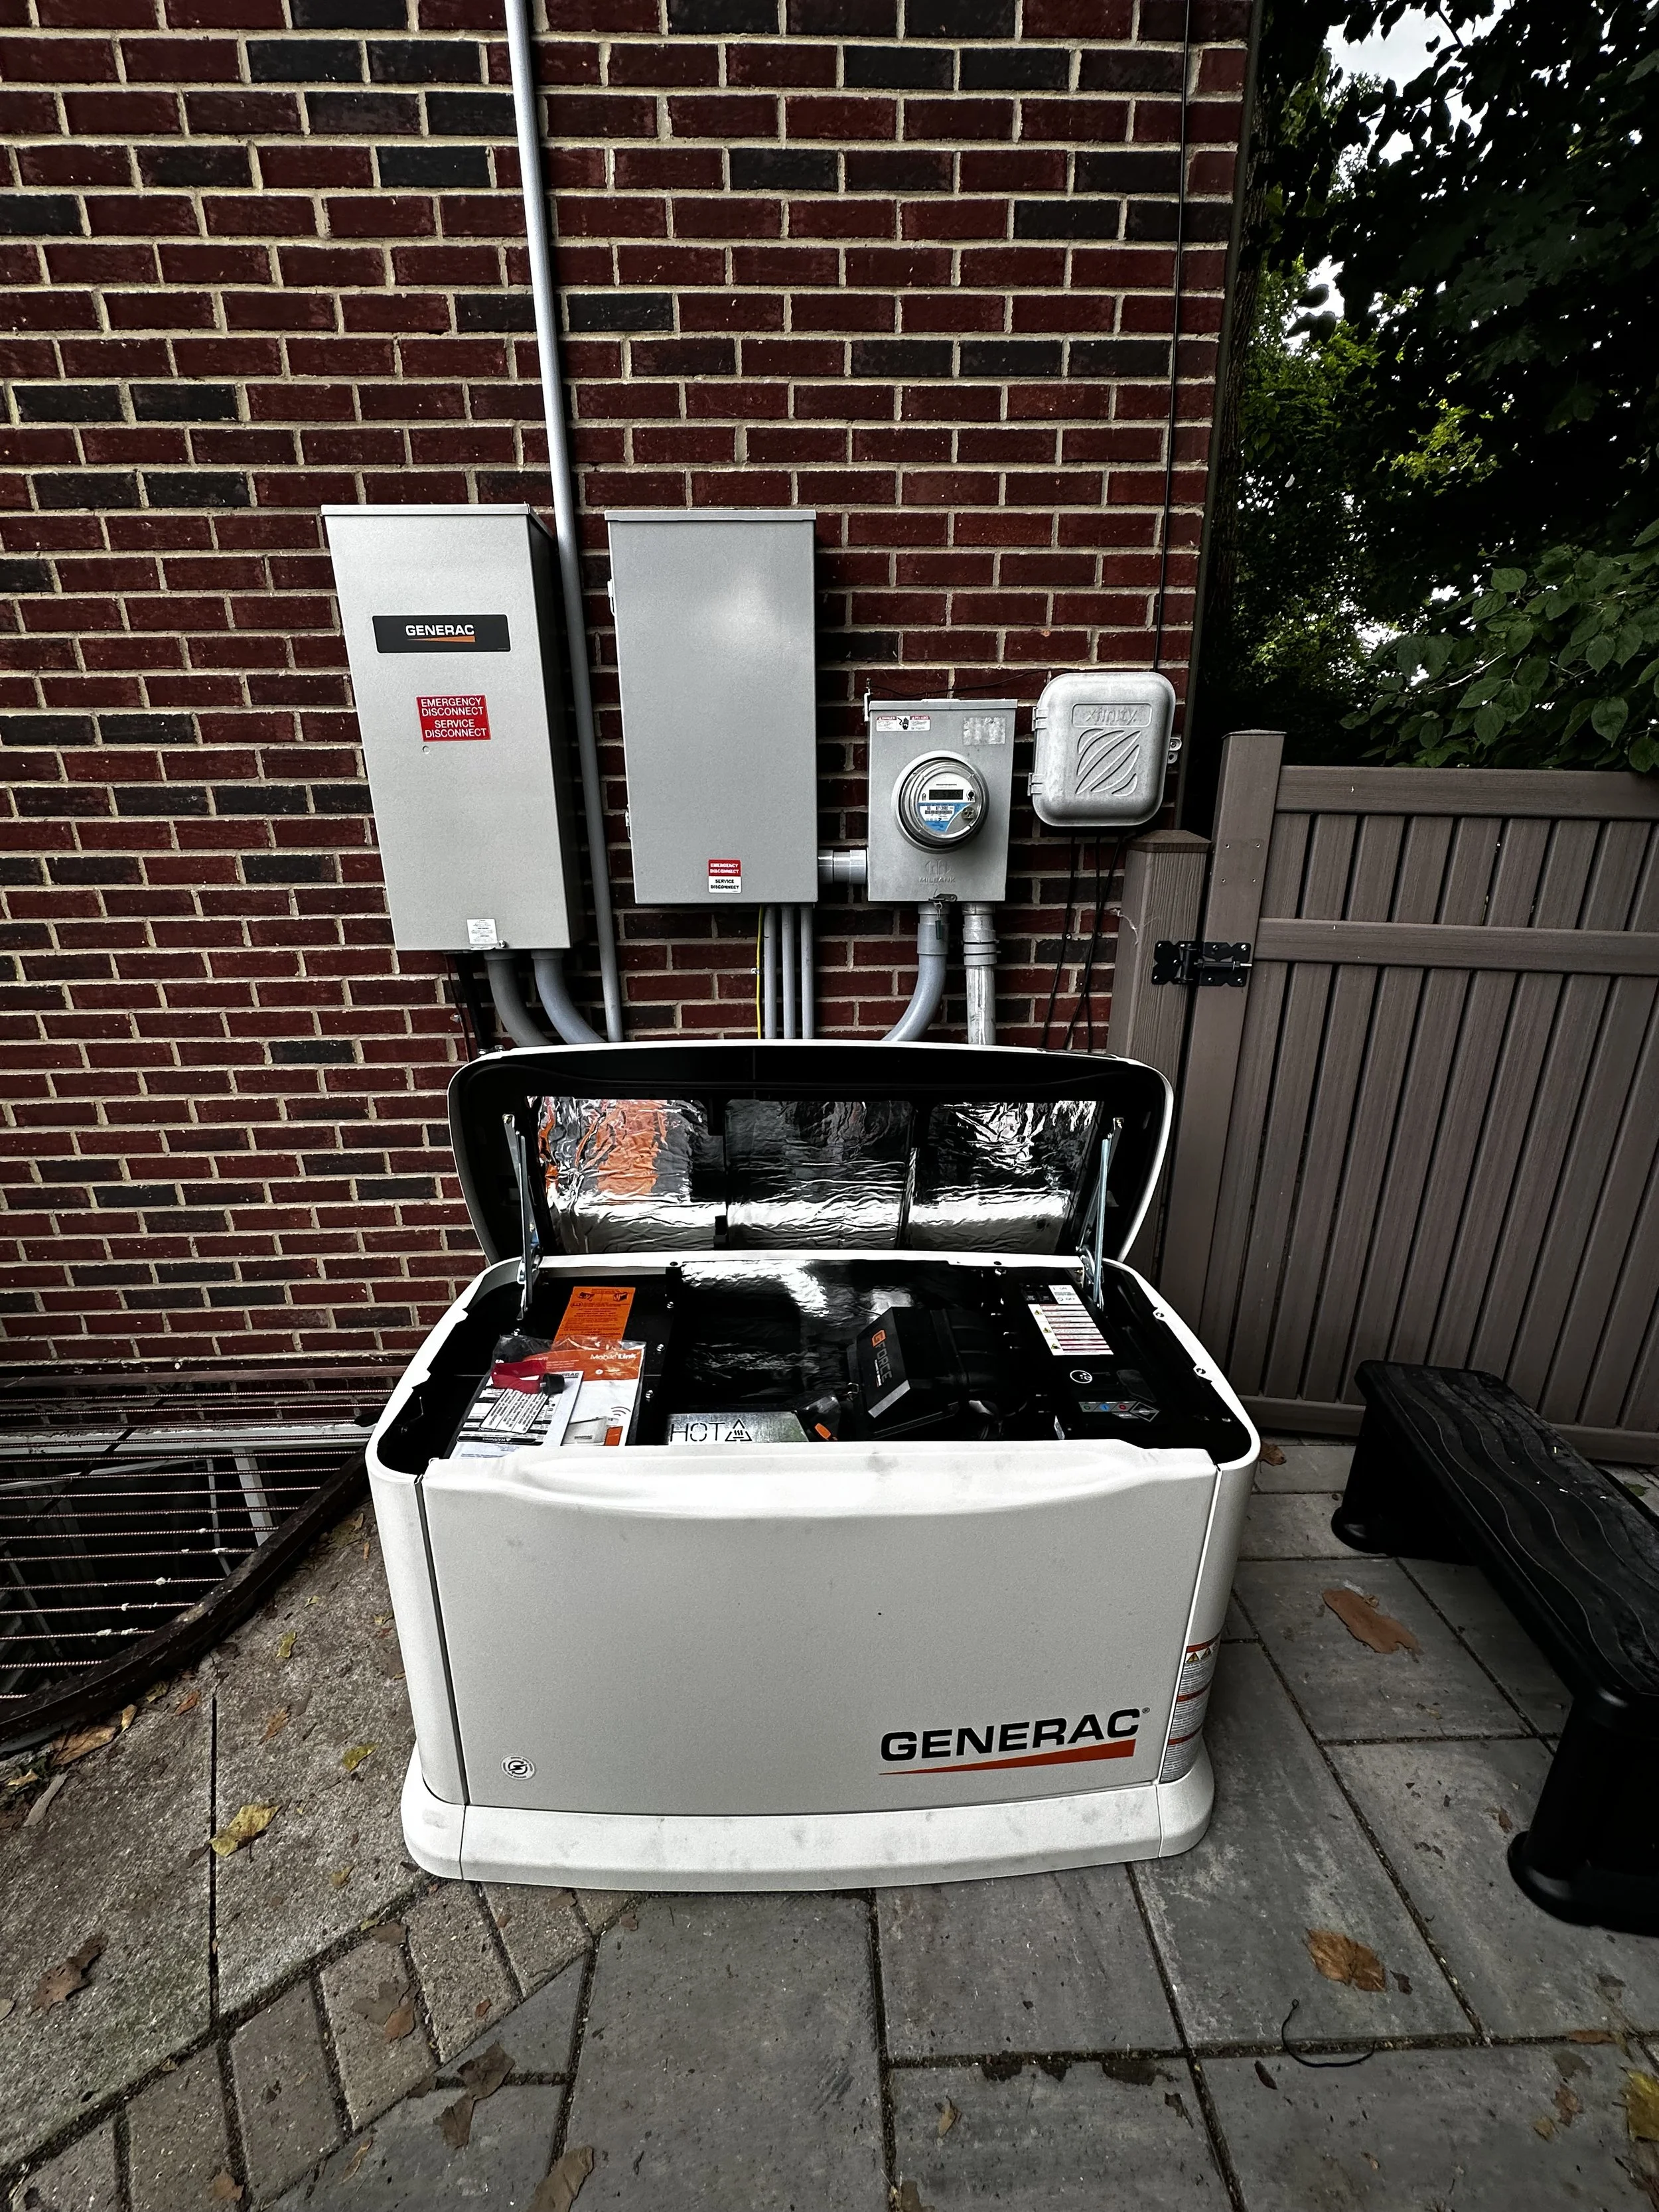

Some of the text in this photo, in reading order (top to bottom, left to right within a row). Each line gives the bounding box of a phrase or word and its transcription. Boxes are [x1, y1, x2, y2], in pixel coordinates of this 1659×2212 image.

[405, 625, 474, 636] GENERAC
[421, 698, 482, 707] EMERGENCY
[421, 707, 484, 717] DISCONNECT
[435, 719, 475, 728] SERVICE
[425, 728, 486, 738] DISCONNECT
[670, 1422, 725, 1442] HOT
[881, 1708, 1141, 1761] GENERAC
